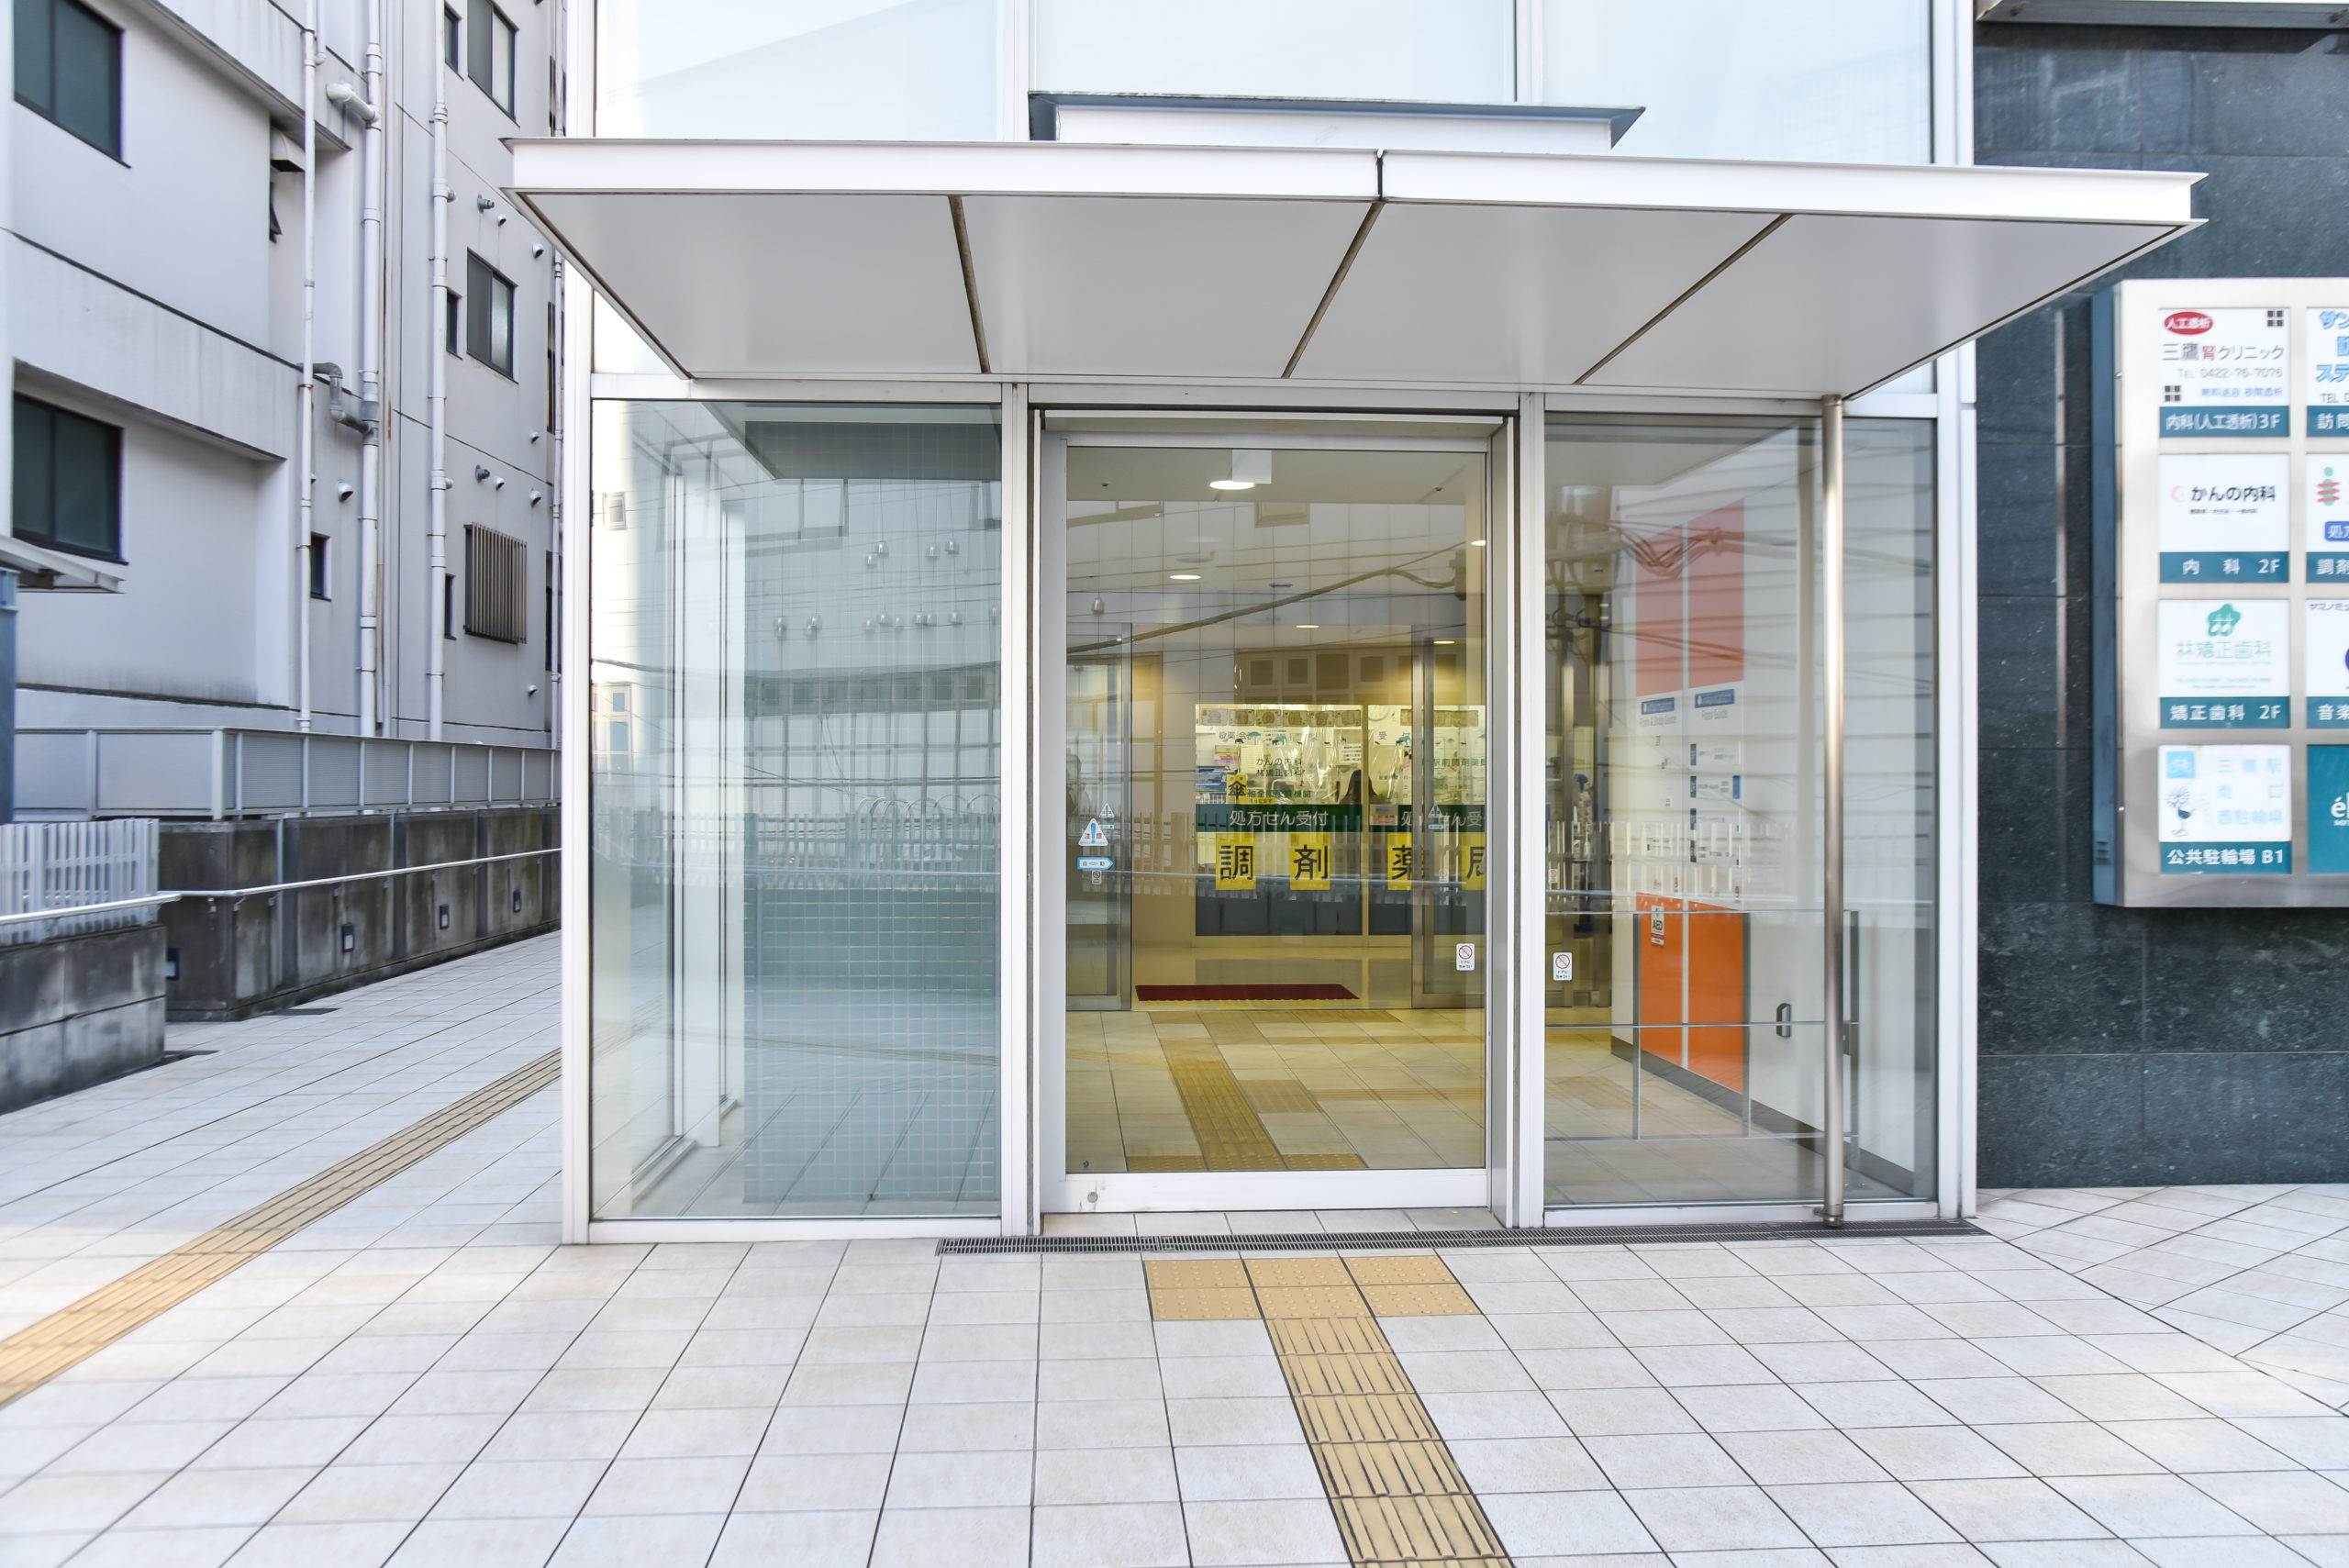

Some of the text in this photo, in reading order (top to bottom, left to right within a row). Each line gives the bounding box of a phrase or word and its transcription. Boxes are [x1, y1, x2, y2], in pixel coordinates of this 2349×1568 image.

[2191, 486, 2276, 502] かんの内科
[2258, 559, 2280, 573] 2F
[2170, 705, 2281, 721] 矯正歯科 2F
[1228, 780, 1247, 800] 傘
[1230, 810, 1329, 826] 処方せん受付
[2262, 850, 2283, 864] B1
[1653, 919, 1663, 931] AED
